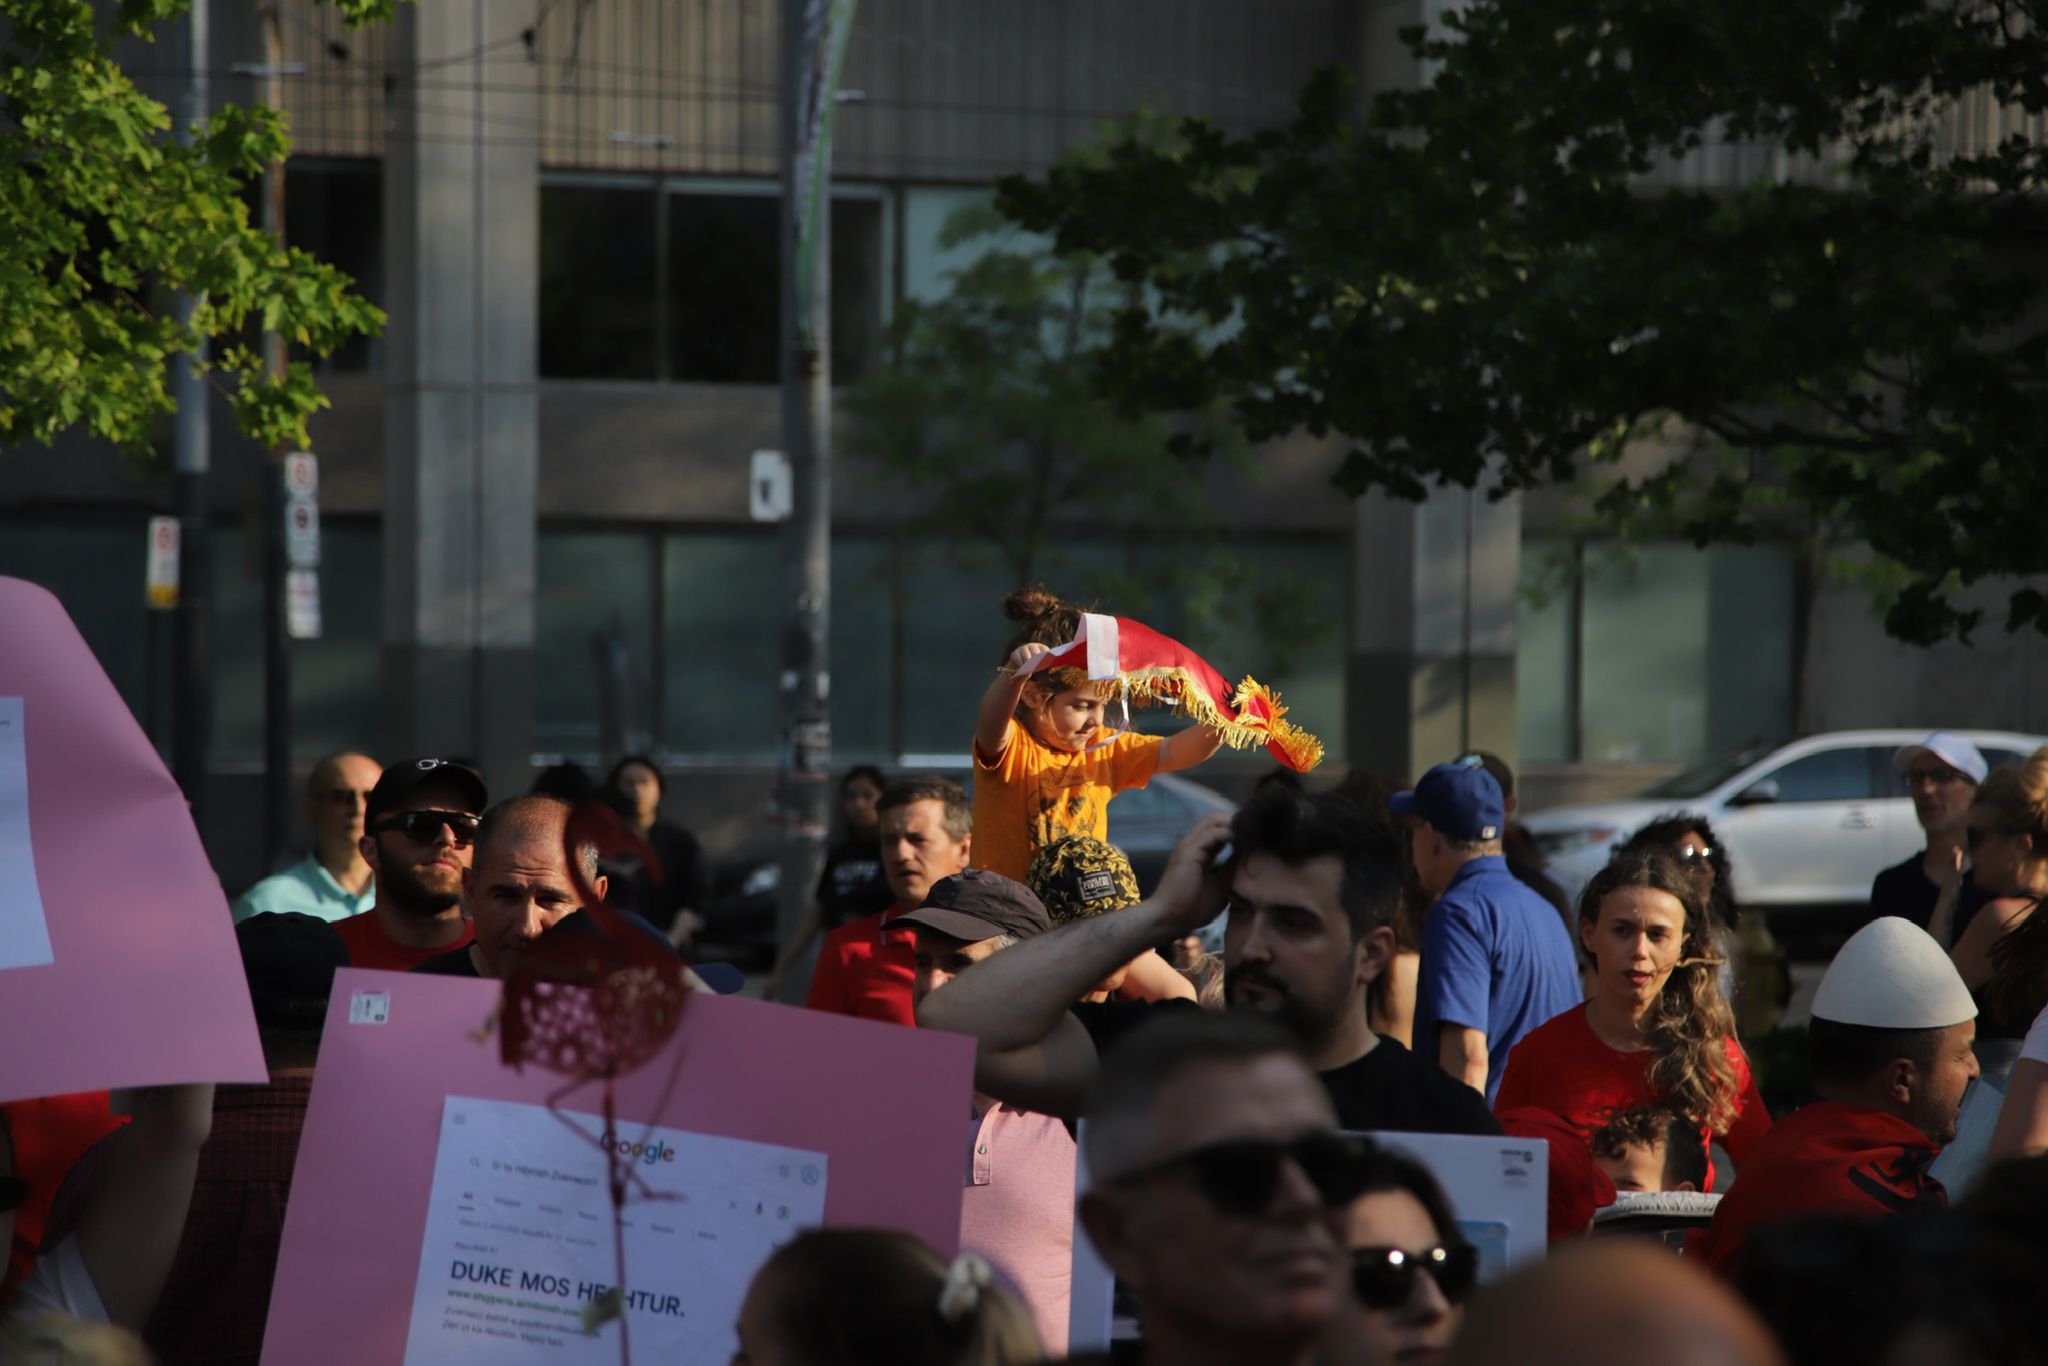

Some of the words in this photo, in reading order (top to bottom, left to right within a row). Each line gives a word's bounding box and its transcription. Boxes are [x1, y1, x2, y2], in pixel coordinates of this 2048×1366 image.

[600, 1131, 675, 1166] Google
[451, 1259, 514, 1287] DUKE
[520, 1271, 570, 1298] MOS
[577, 1281, 685, 1318] HEHTUR.
